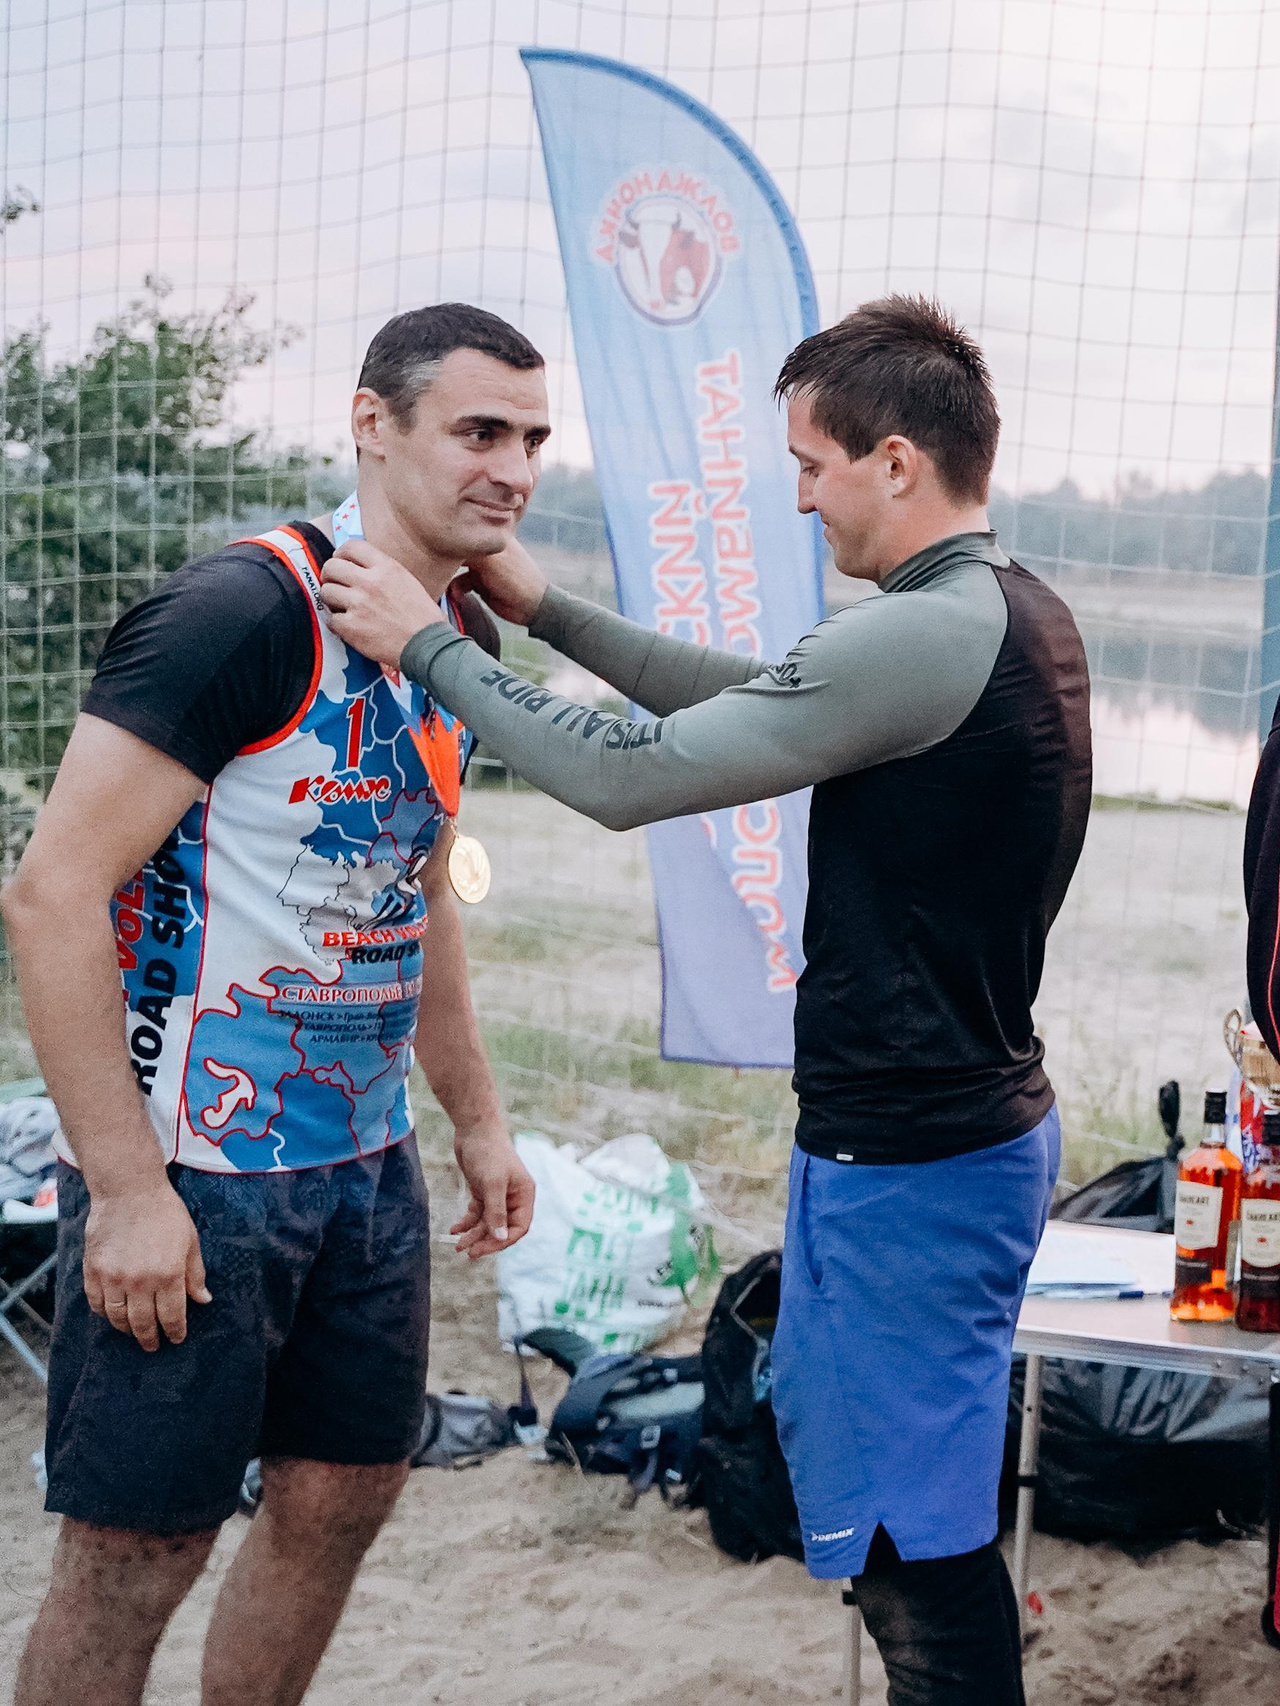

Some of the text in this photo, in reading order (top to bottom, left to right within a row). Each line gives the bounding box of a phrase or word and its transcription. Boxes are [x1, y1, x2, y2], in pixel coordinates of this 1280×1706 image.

[346, 697, 366, 770] 1
[323, 929, 395, 947] BEACH
[351, 943, 403, 964] ROAD
